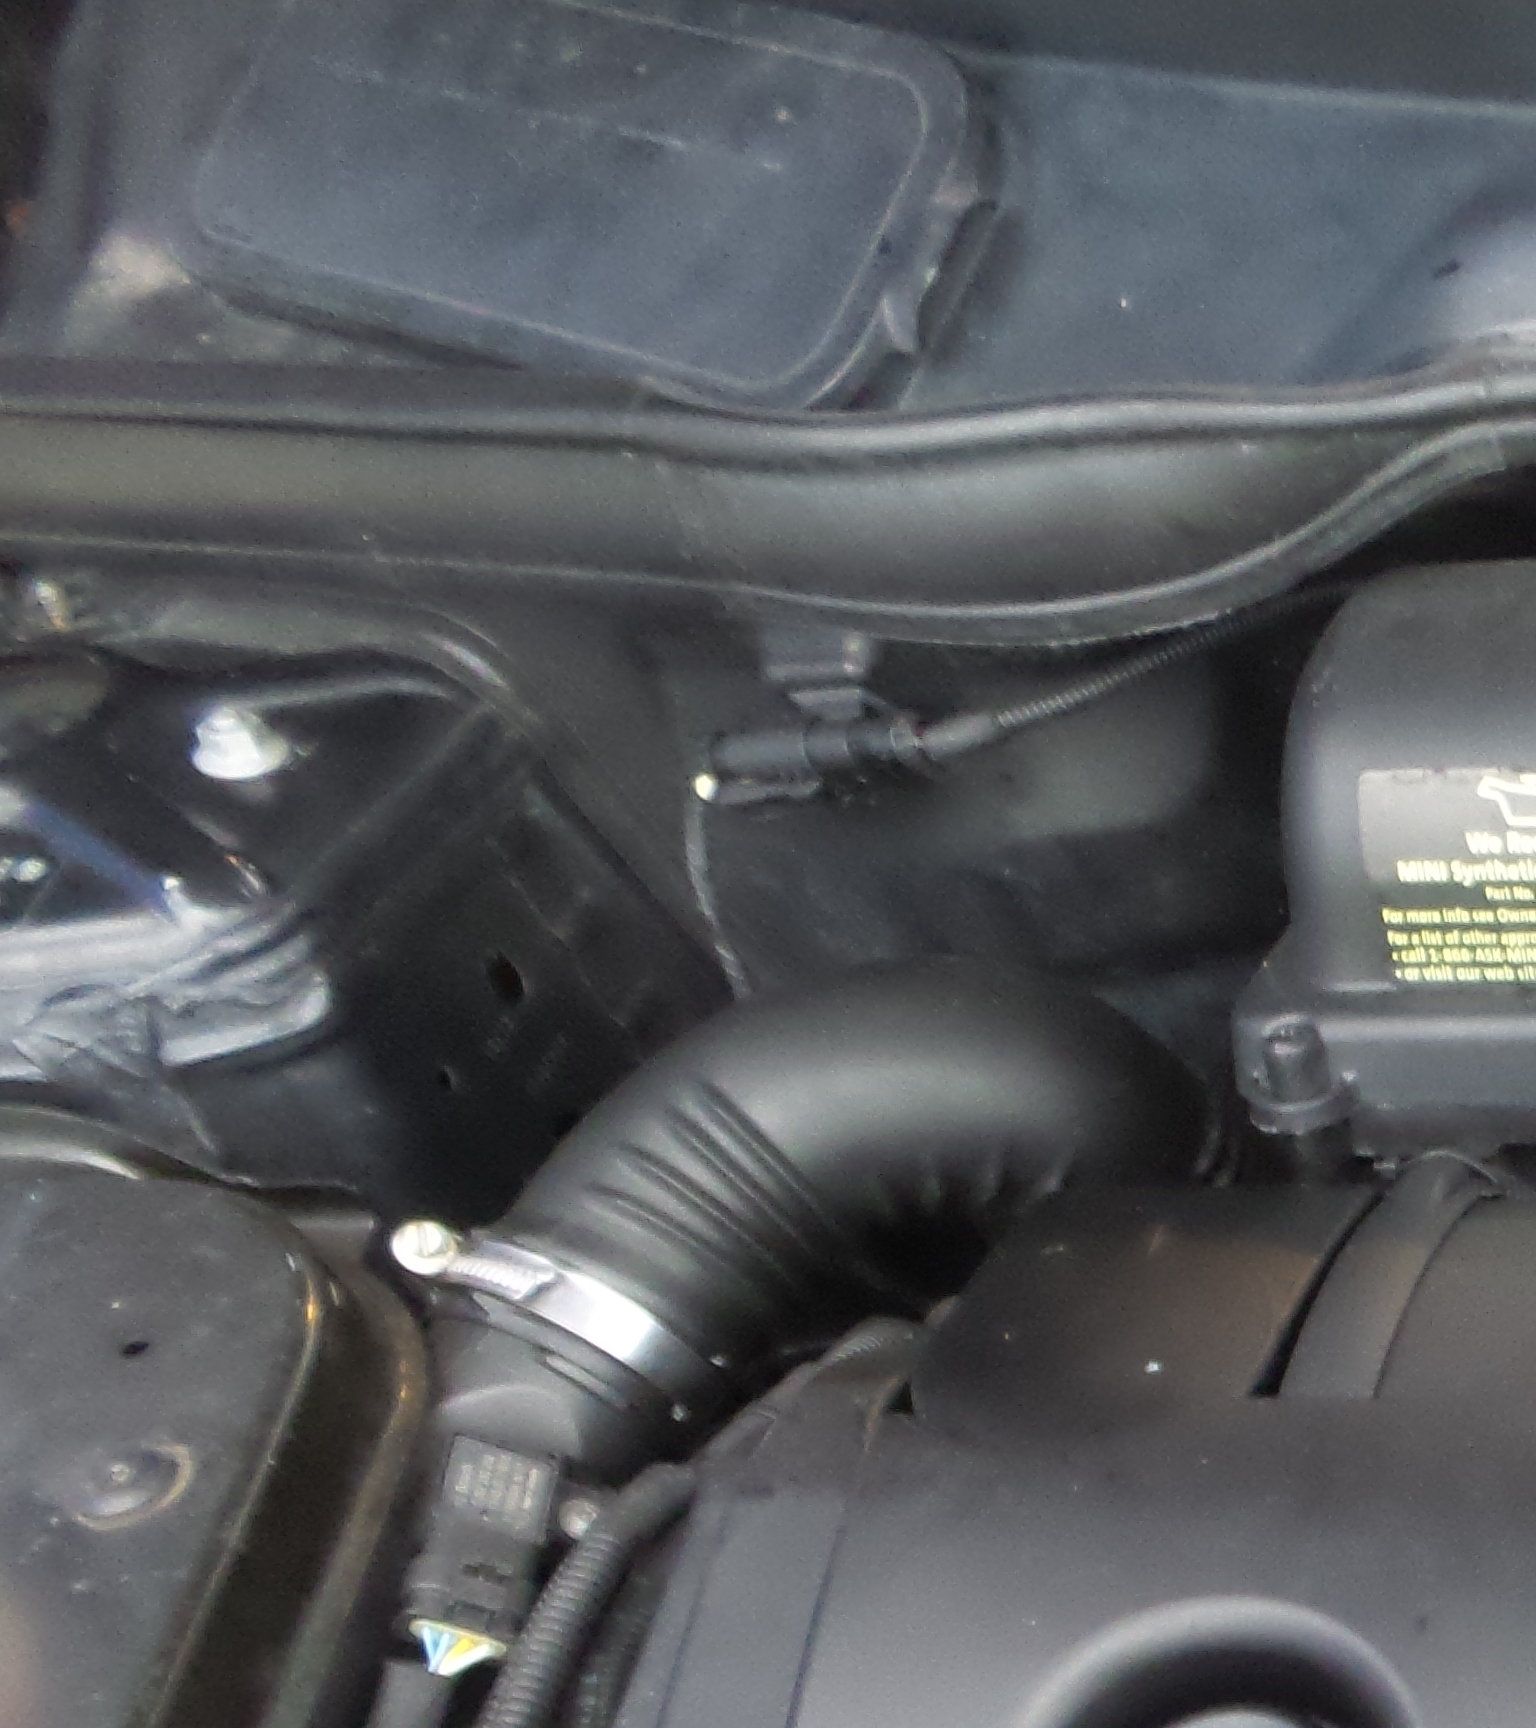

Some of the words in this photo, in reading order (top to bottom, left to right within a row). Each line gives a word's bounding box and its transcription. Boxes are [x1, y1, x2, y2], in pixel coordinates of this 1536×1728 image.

[1465, 831, 1503, 854] We
[1397, 859, 1449, 883] MINI
[1485, 884, 1511, 901] Part
[1382, 907, 1404, 924] For
[1405, 909, 1442, 924] more
[1387, 929, 1409, 946] For
[1421, 929, 1443, 946] list
[1445, 928, 1460, 945] of
[1462, 928, 1498, 945] other
[1401, 946, 1426, 963] call
[1404, 967, 1420, 981] or
[1422, 964, 1453, 981] visit
[1456, 966, 1480, 981] our
[1483, 963, 1515, 980] web
